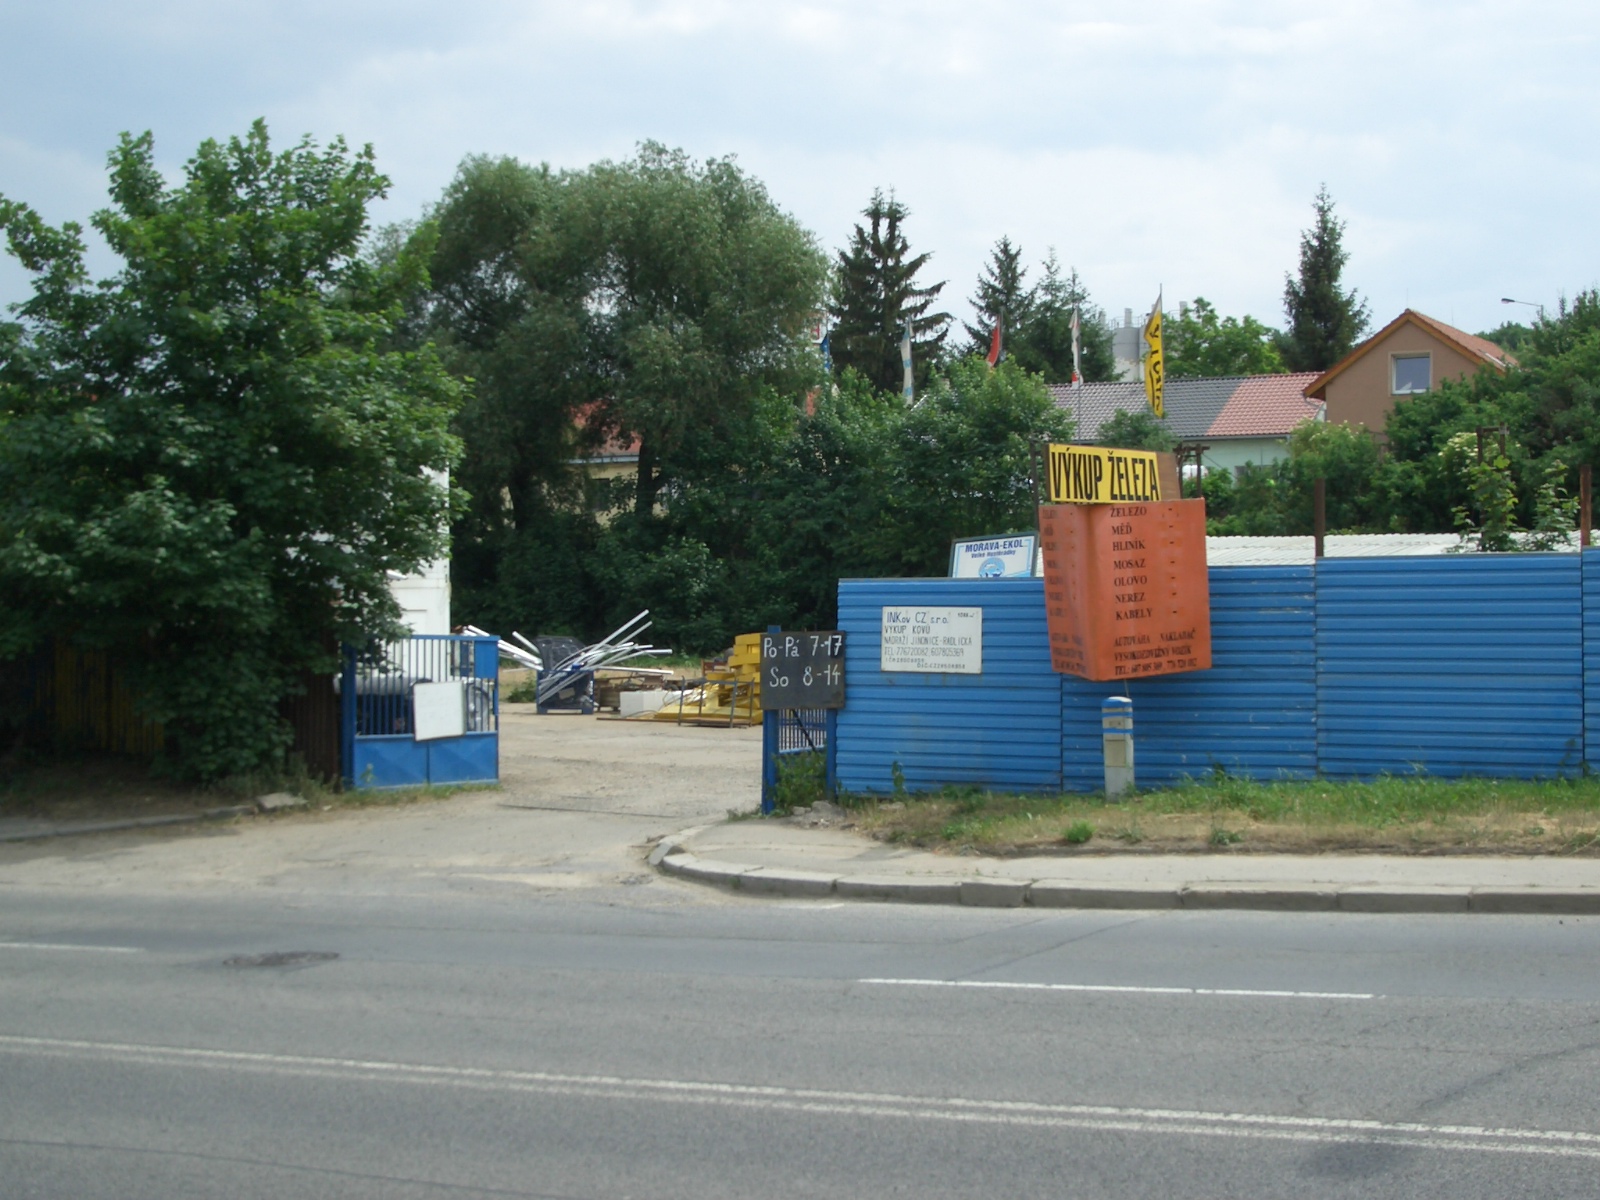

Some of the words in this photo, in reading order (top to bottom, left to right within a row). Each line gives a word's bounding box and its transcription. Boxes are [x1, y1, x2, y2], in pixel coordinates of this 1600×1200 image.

[1051, 447, 1103, 500] VÝKUP
[1108, 450, 1160, 501] ŽELEZA
[1110, 506, 1147, 518] ŽELEZO
[965, 539, 1023, 553] MORAVA-EKOL
[1112, 538, 1146, 551] HLINÍK
[1113, 559, 1146, 570] MOSAZ
[1114, 575, 1147, 587] OLOVO
[1115, 592, 1146, 604] NEREZ
[887, 612, 911, 624] INKov
[915, 612, 927, 624] CZ
[1116, 608, 1153, 621] KABELY
[769, 666, 789, 687] So
